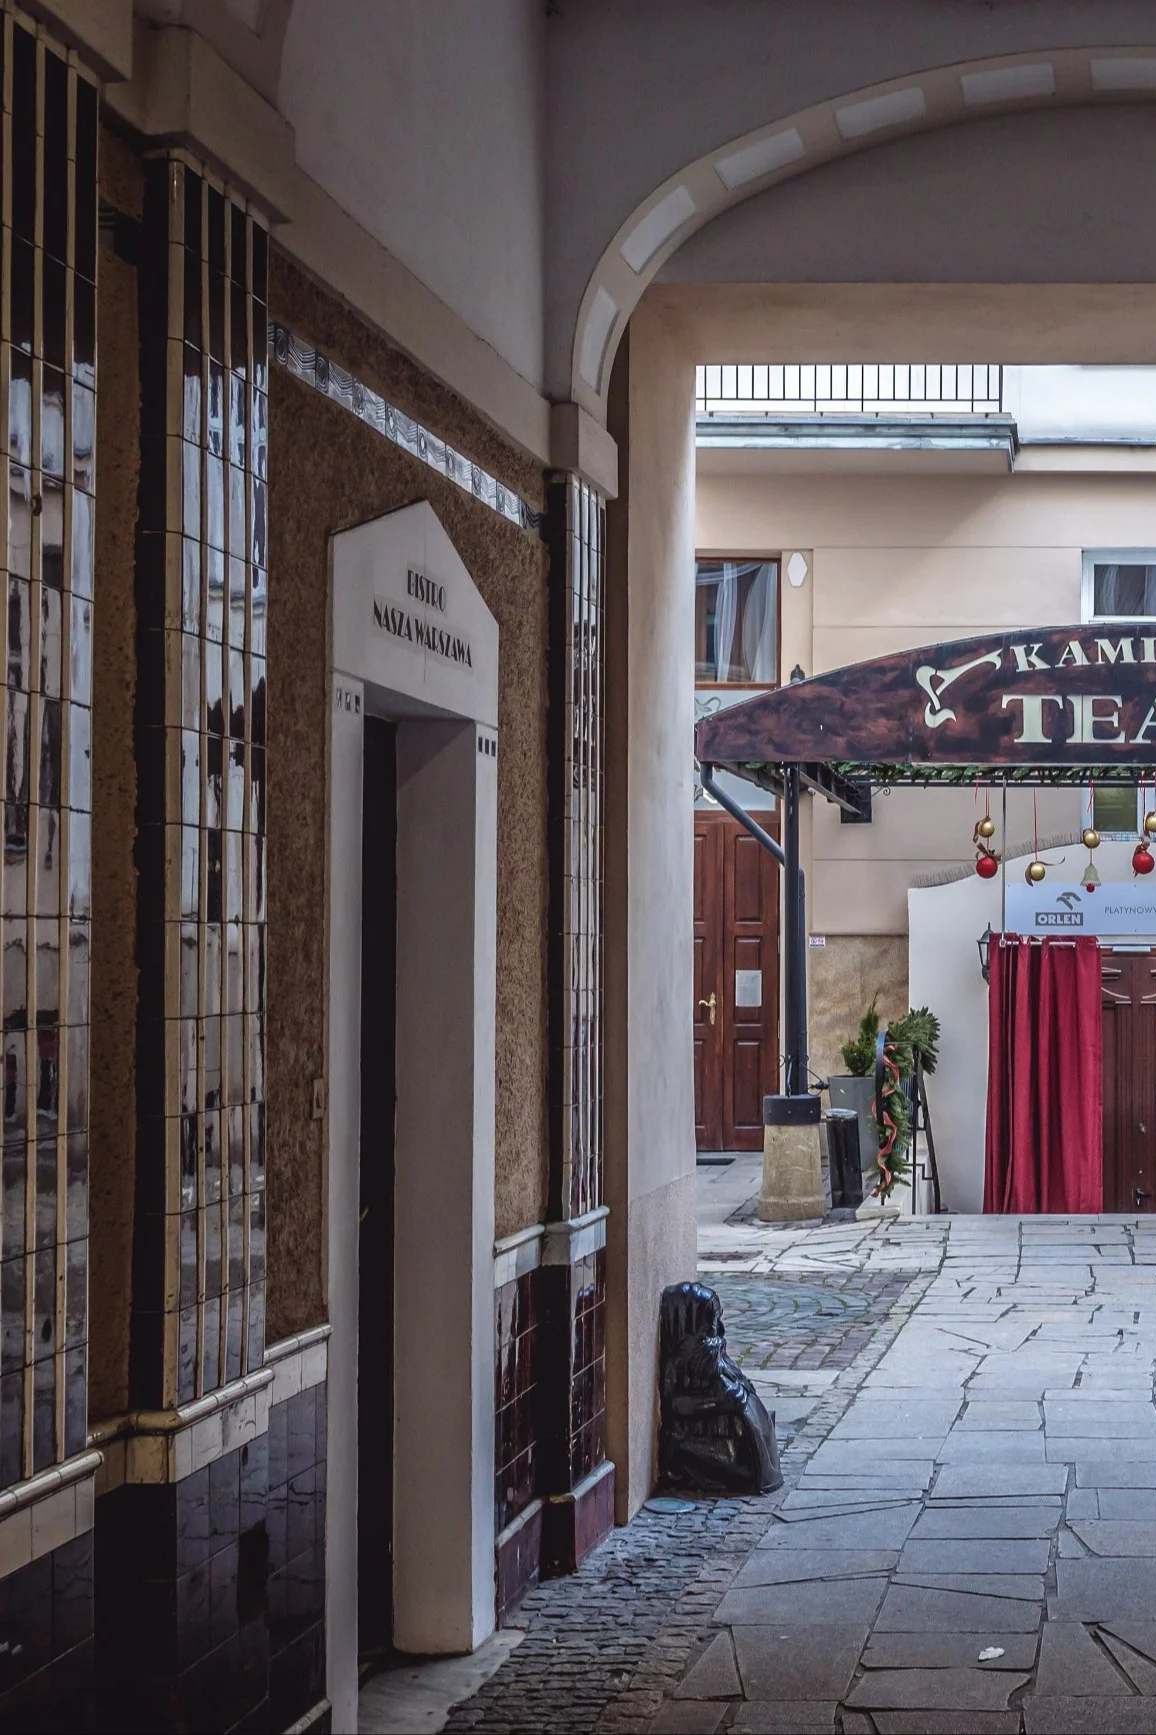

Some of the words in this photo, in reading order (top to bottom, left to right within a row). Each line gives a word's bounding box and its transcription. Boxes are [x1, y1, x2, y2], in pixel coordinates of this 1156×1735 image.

[407, 570, 446, 612] BISTRO
[373, 599, 412, 642] NASZA
[415, 619, 472, 668] WARSZAWA
[1037, 913, 1081, 925] ORLEN
[1104, 906, 1156, 914] PLATYNOWY
